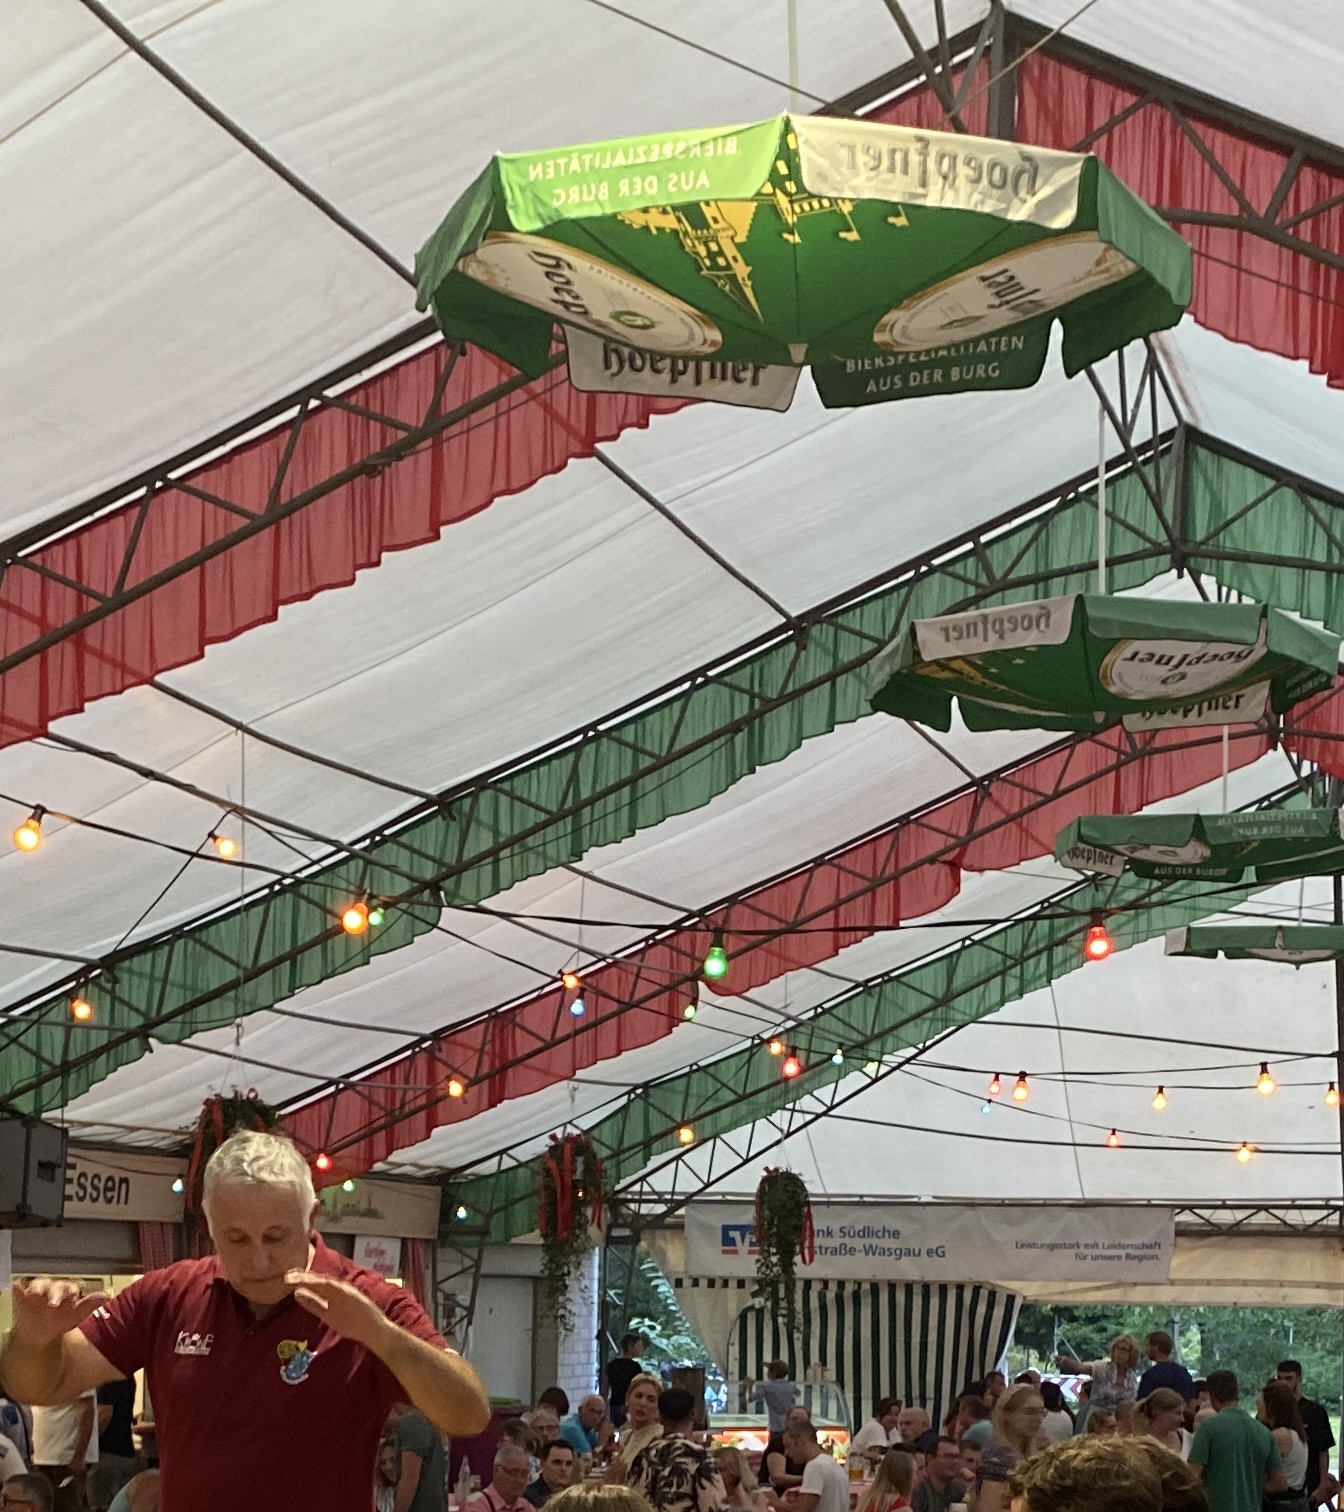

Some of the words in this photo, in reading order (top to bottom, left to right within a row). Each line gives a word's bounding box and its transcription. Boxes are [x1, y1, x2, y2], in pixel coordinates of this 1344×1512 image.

[865, 375, 902, 394] AUS
[908, 369, 944, 386] DER
[950, 362, 1000, 382] BURG
[64, 1162, 130, 1206] Essen
[839, 1225, 901, 1240] Südliche
[926, 1245, 946, 1258] eG
[1015, 1241, 1081, 1251] Leistungsstark
[1084, 1241, 1099, 1249] mit
[1102, 1241, 1161, 1250] Leidenschaft
[1075, 1252, 1089, 1261] für
